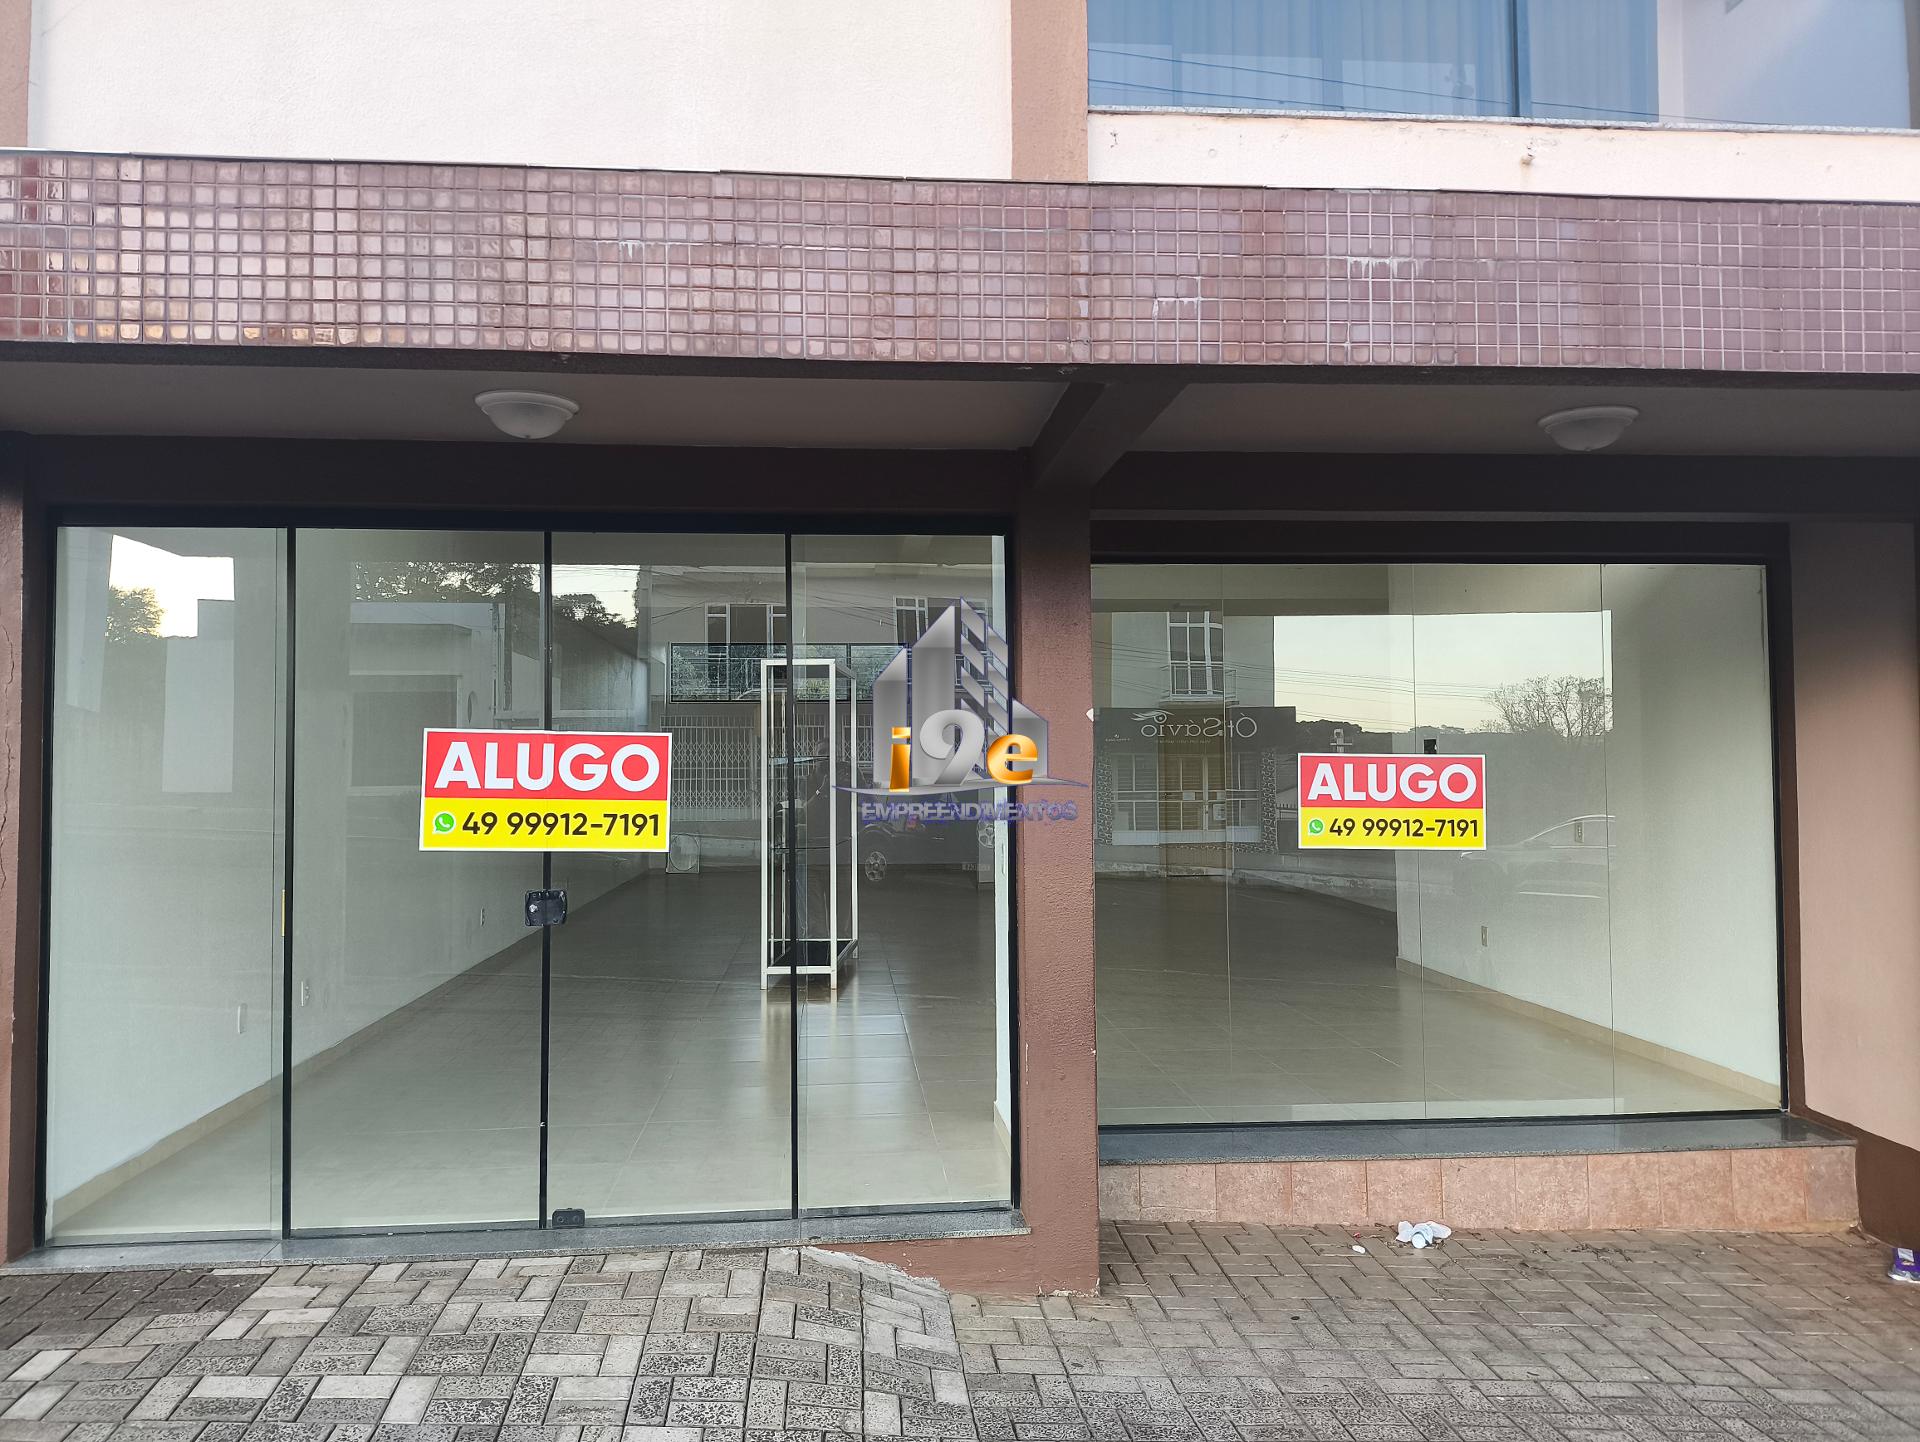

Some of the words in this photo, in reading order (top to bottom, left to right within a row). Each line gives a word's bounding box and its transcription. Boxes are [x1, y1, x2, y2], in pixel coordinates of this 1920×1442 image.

[434, 741, 660, 792] ALUGO
[1307, 762, 1477, 803] ALUGO
[462, 811, 498, 835] 49
[507, 812, 659, 836] 99912-7191
[1329, 818, 1356, 837] 49
[1362, 818, 1478, 838] 99912-7191
